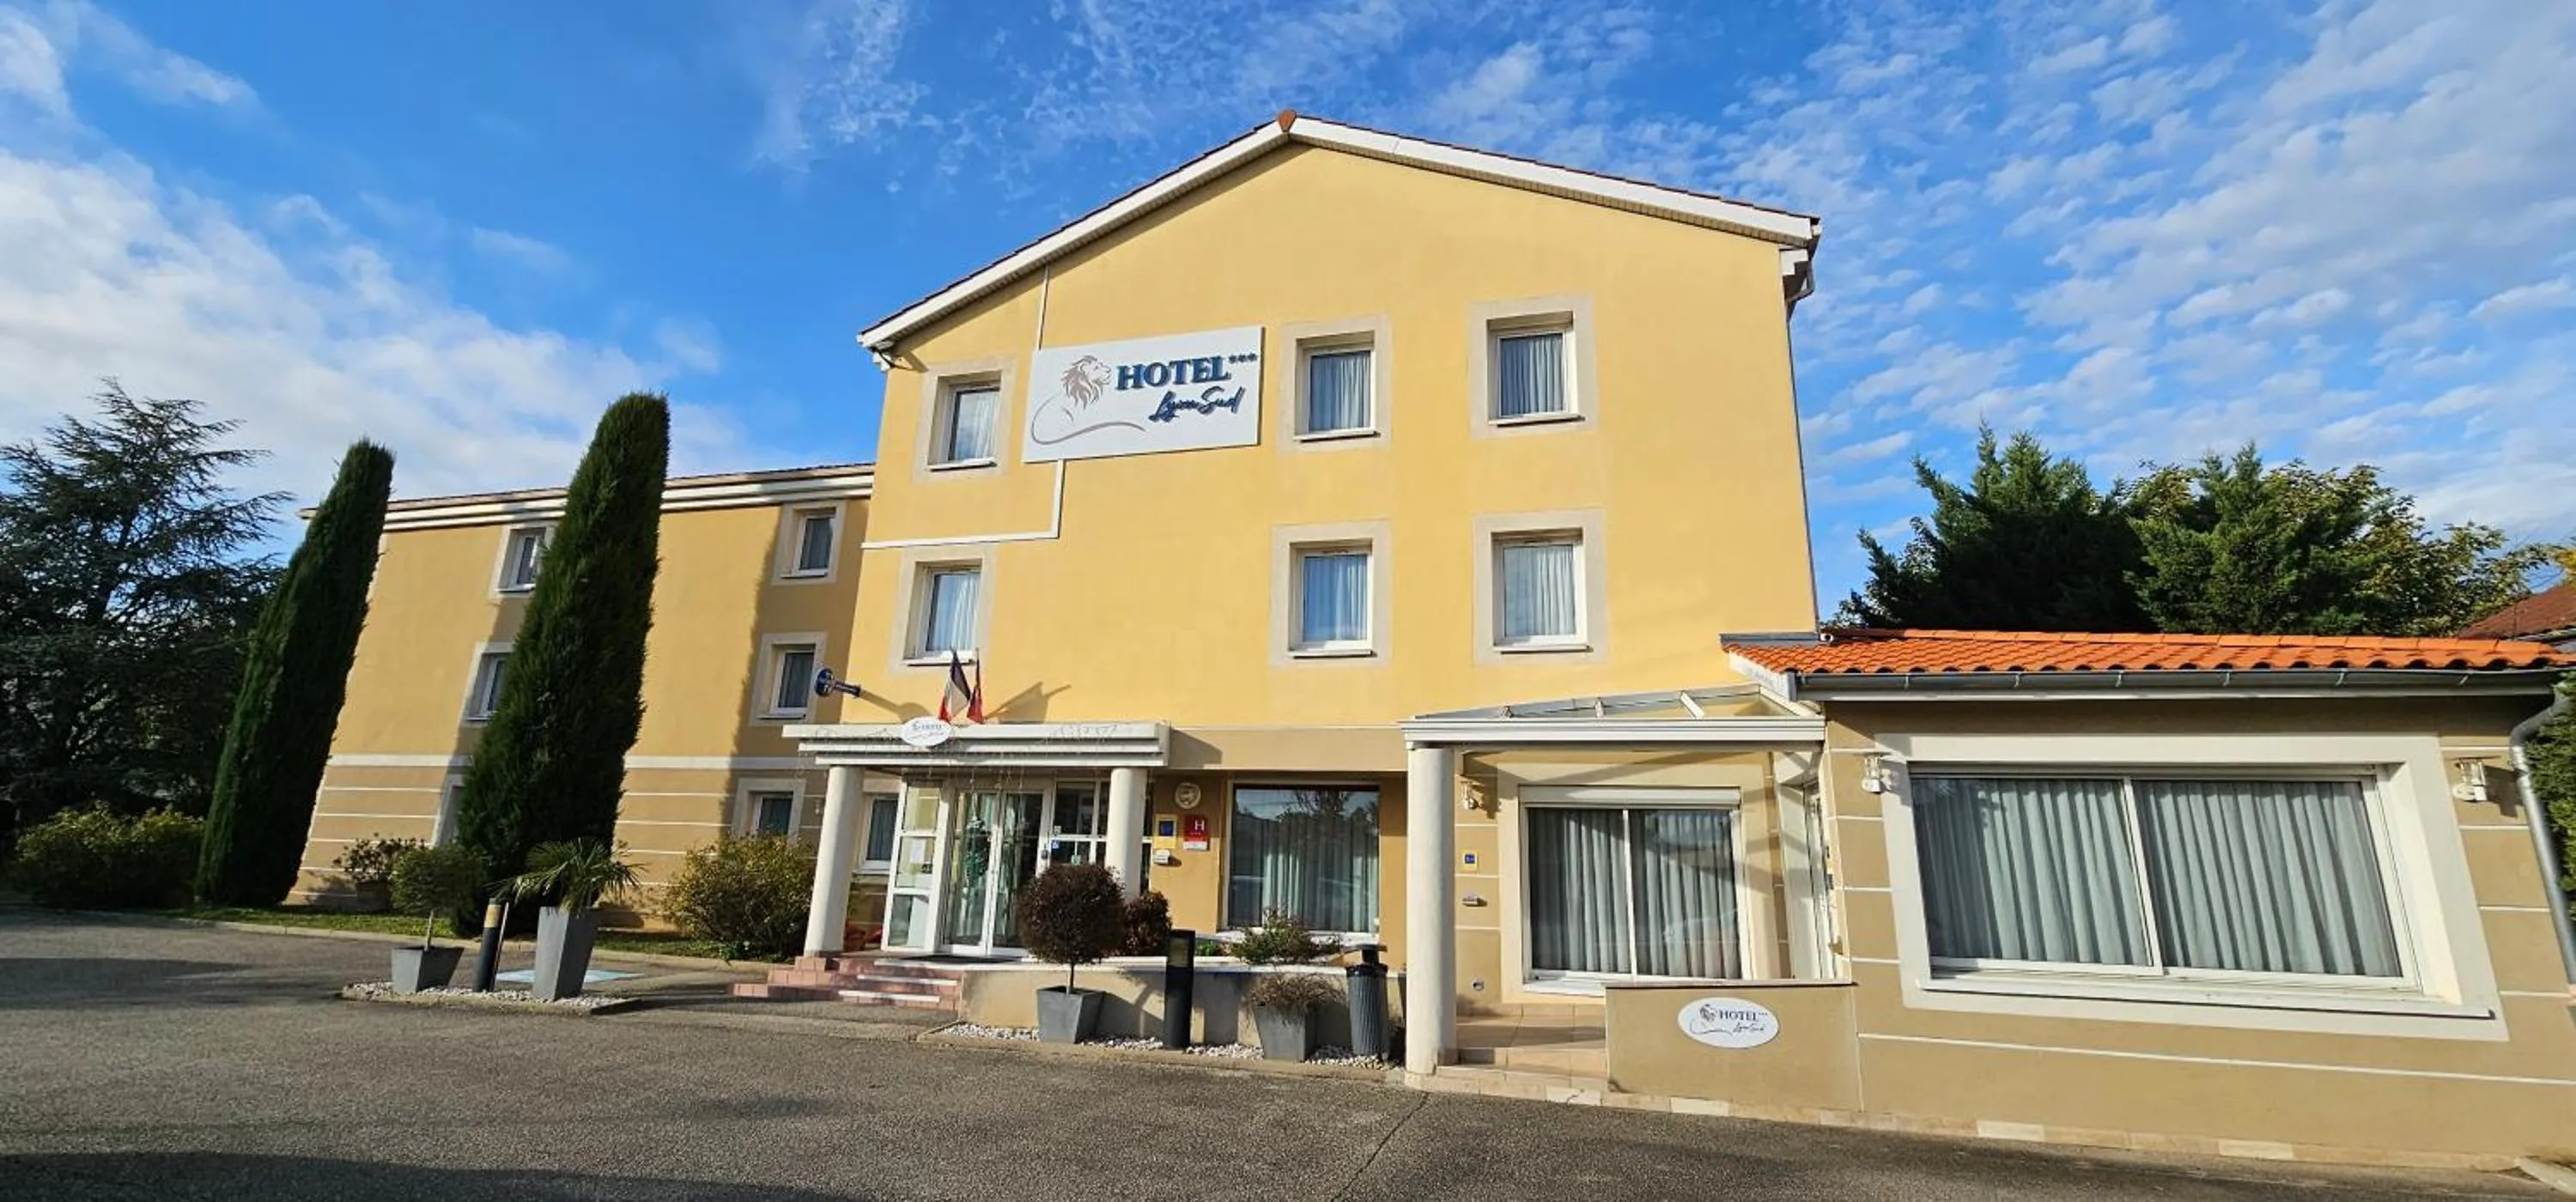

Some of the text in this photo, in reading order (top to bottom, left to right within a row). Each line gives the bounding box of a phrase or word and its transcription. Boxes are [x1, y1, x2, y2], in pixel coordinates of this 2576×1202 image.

[1116, 355, 1231, 391] HOTEL
[1148, 385, 1246, 422] Lyon Sud
[1194, 820, 1205, 831] H
[1719, 1010, 1759, 1022] HOTEL
